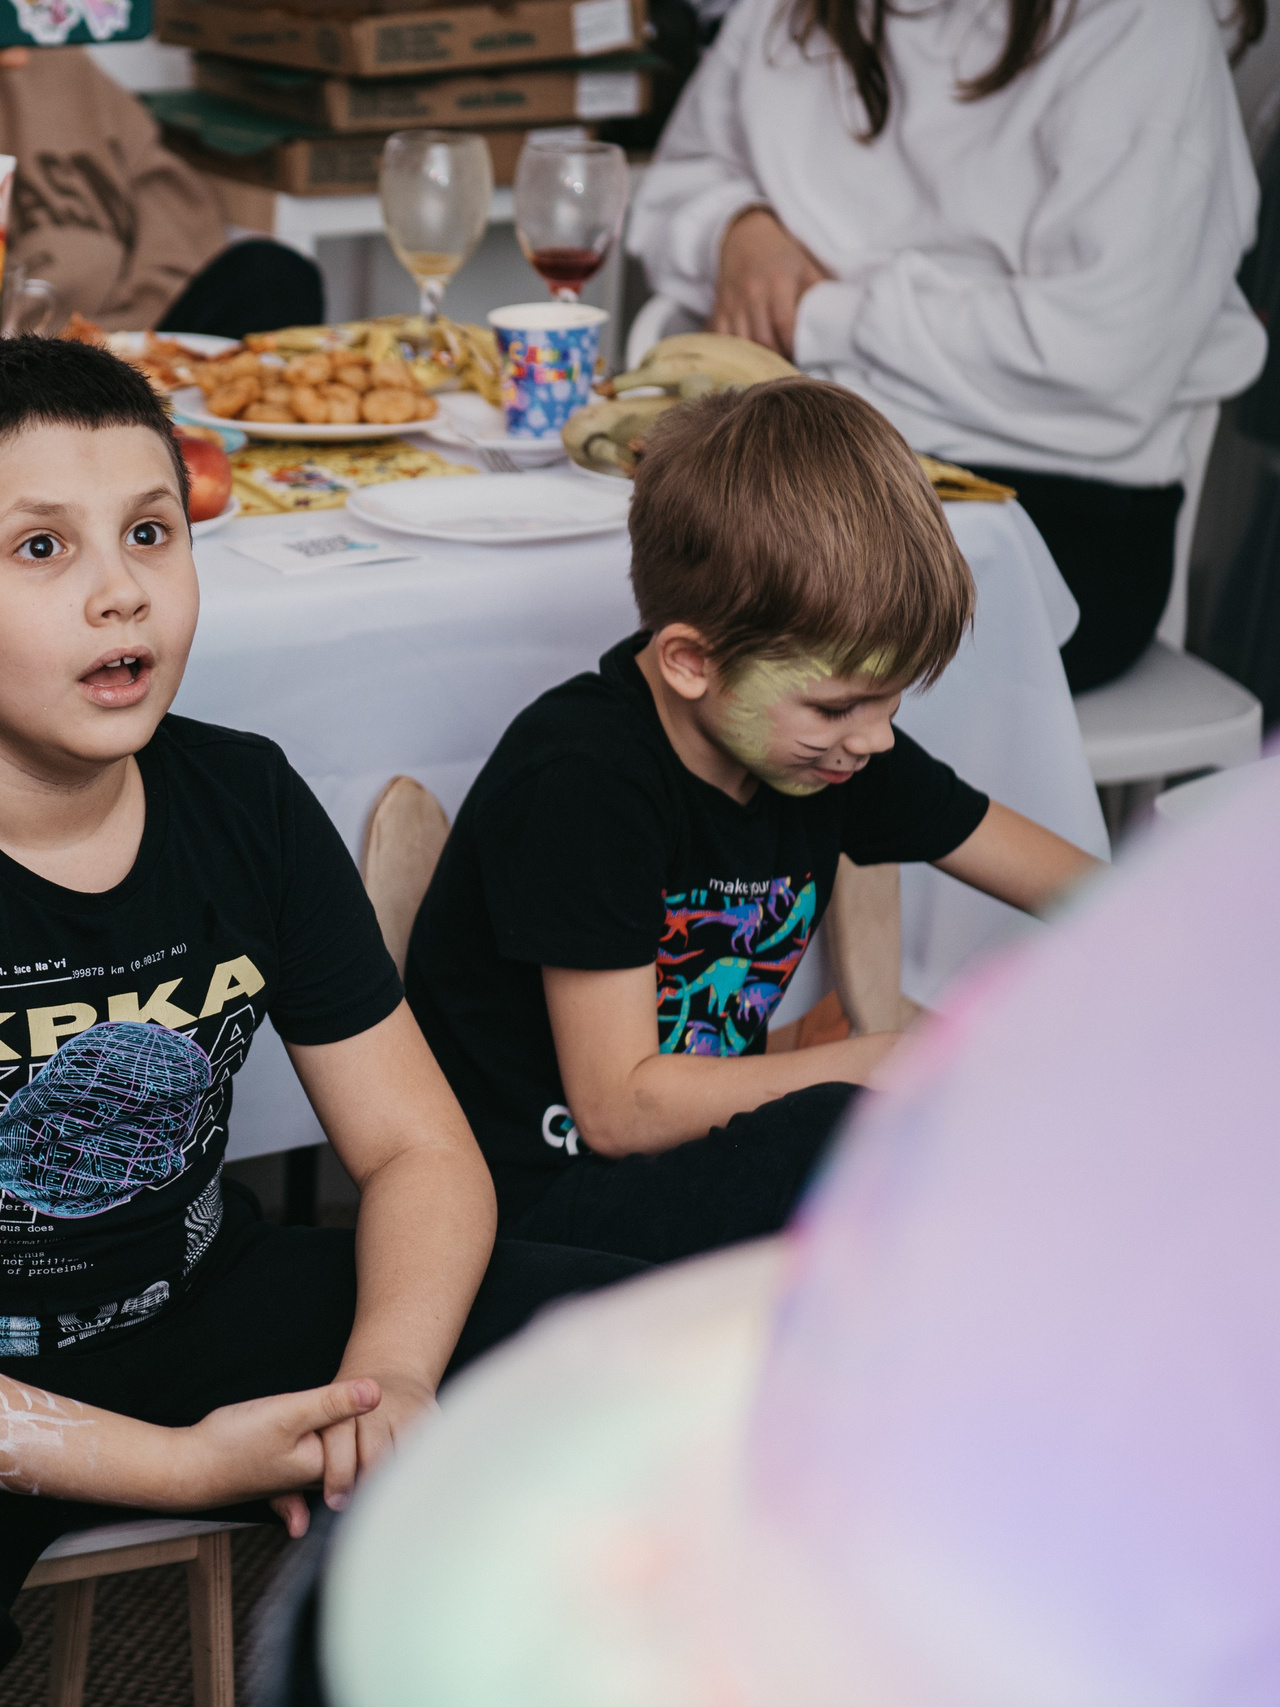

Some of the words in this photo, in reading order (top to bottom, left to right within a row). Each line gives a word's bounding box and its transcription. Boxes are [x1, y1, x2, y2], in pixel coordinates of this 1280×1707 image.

[111, 966, 125, 975] km
[170, 943, 187, 956] AU)
[27, 1224, 54, 1233] does
[2, 1258, 24, 1266] not
[31, 1257, 80, 1266] utili
[7, 1267, 21, 1275] of
[27, 1262, 94, 1277] proteins).
